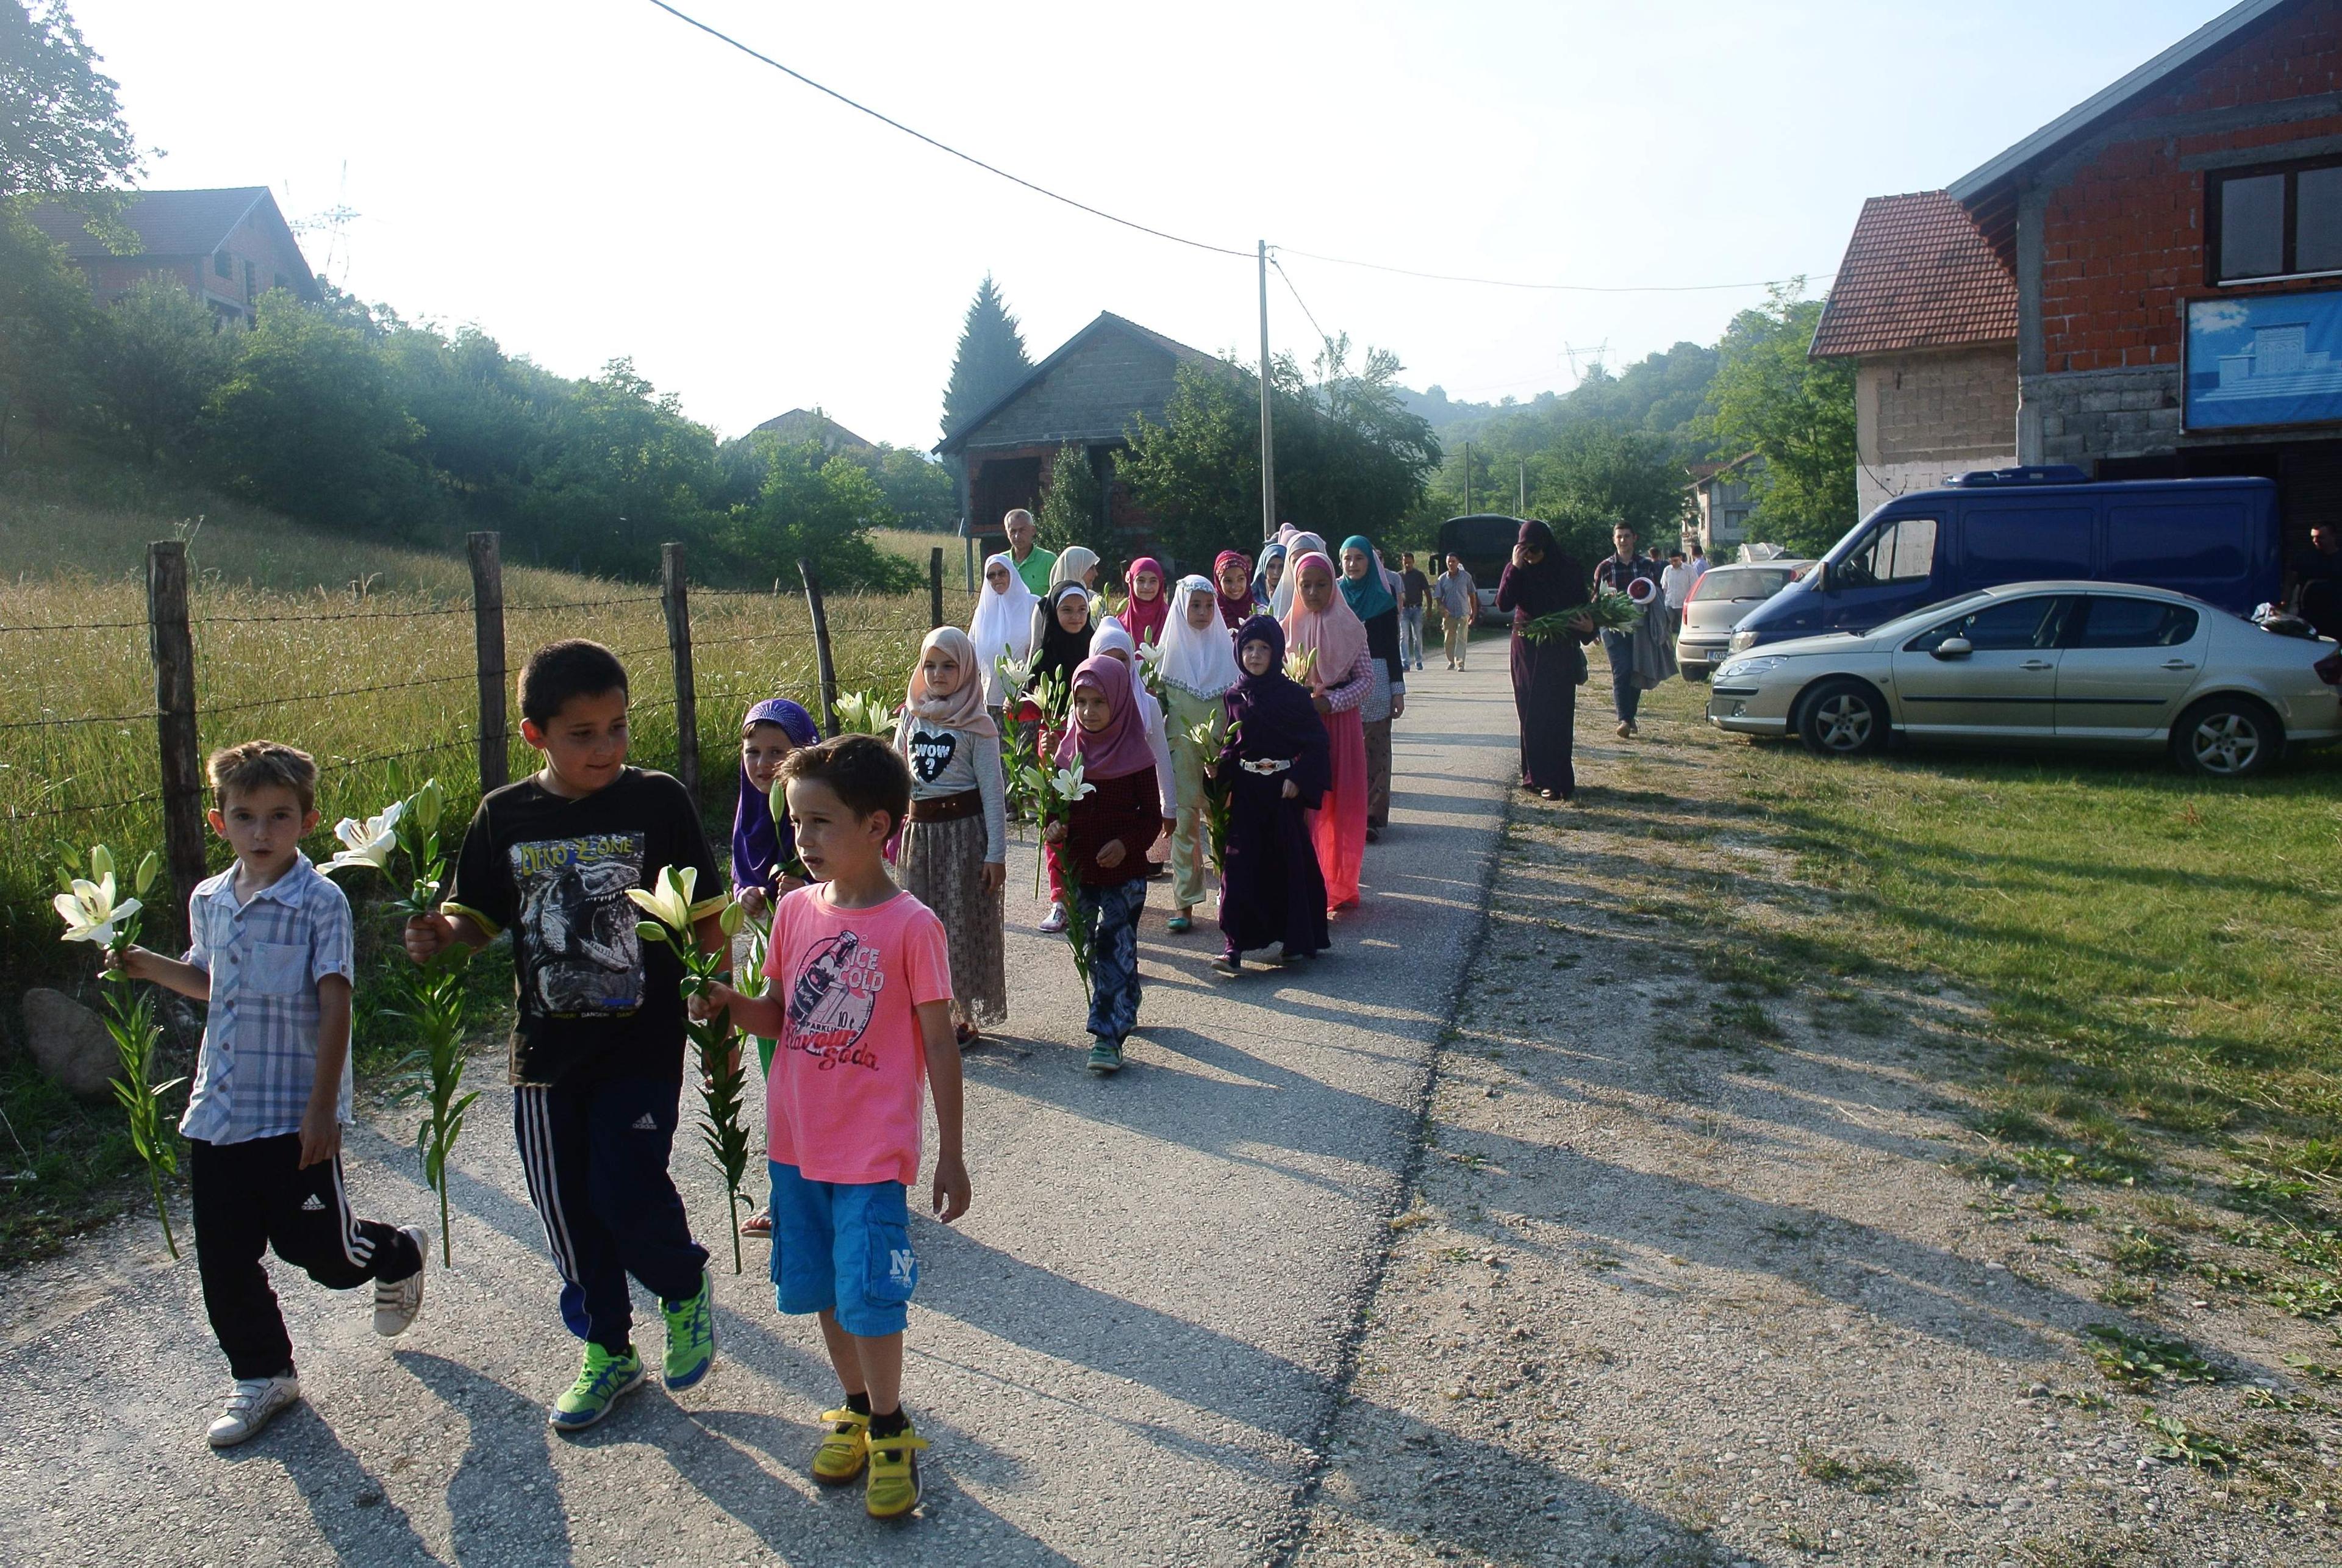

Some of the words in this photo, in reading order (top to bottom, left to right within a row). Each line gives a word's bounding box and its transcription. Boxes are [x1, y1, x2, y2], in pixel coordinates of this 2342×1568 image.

[915, 743, 950, 757] WOW
[925, 758, 935, 775] ?
[521, 845, 568, 877] DINO
[573, 837, 634, 862] ZONE
[850, 945, 880, 970] ICE
[837, 967, 884, 992] COLD
[837, 1011, 848, 1028] 10
